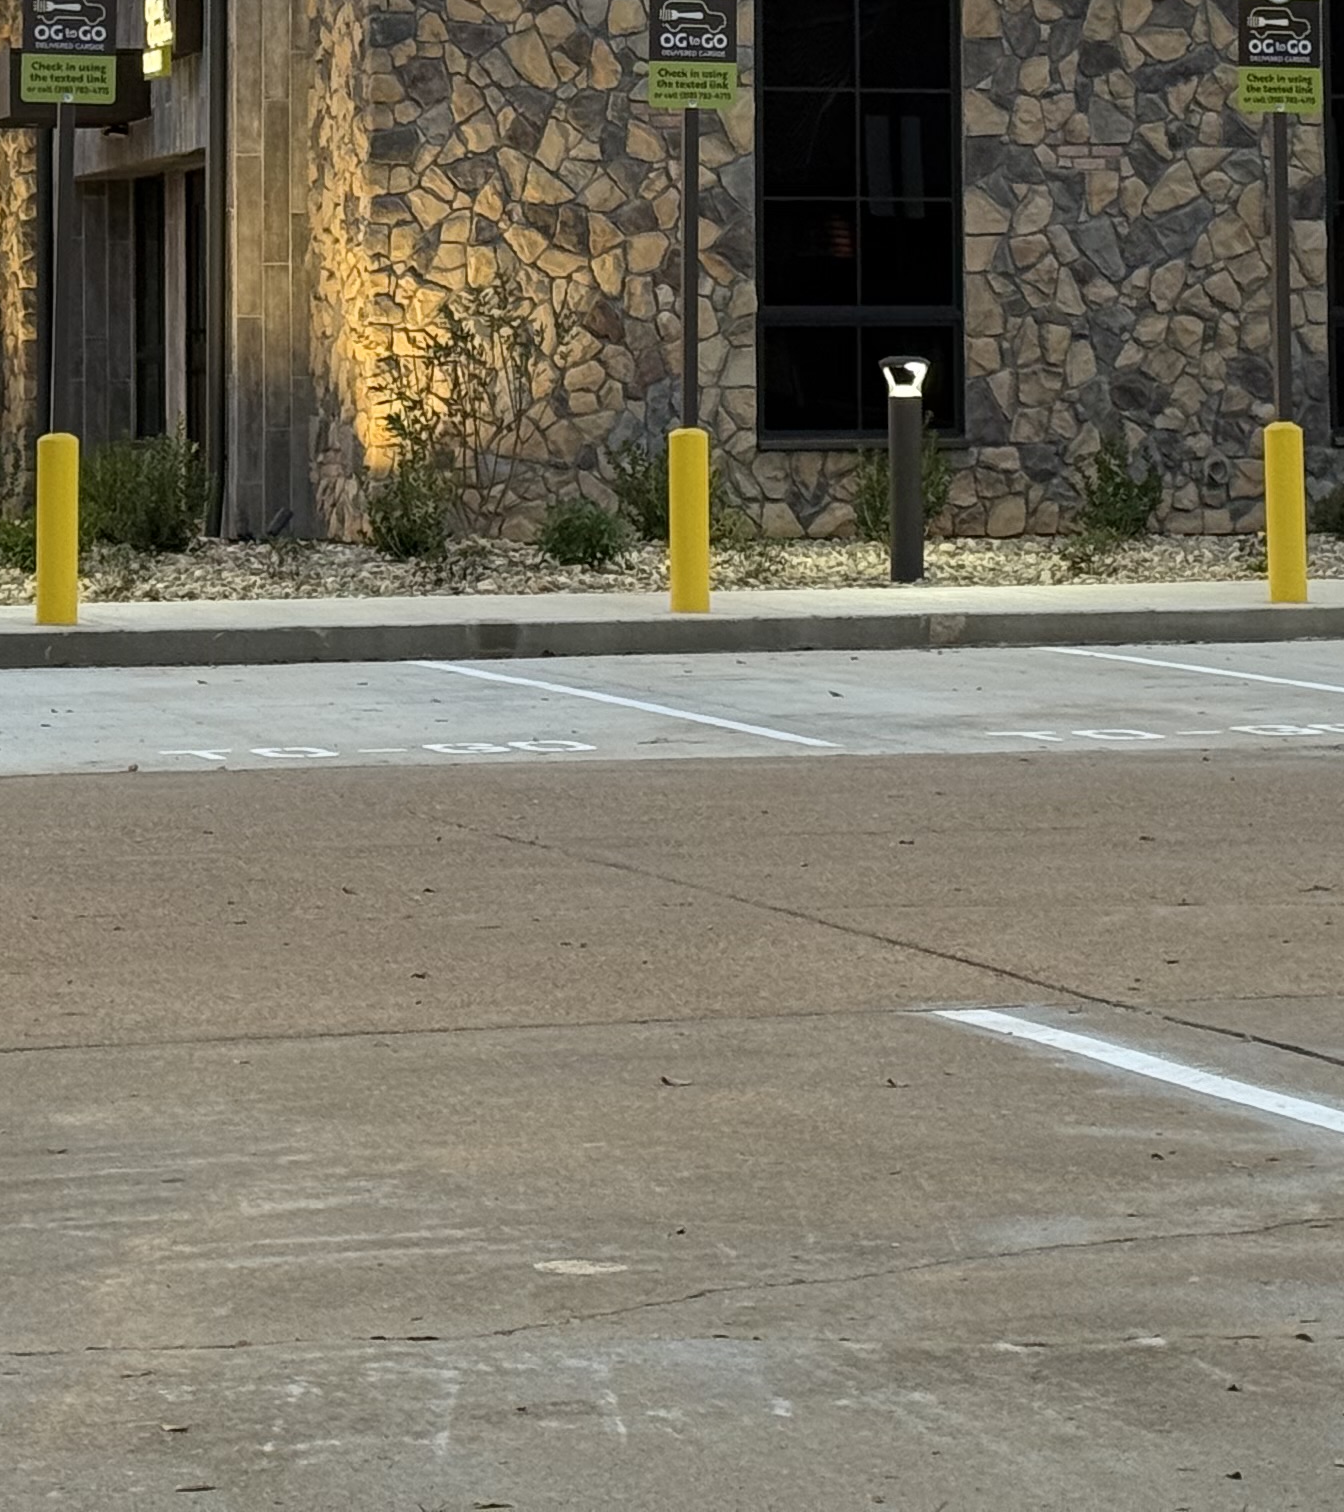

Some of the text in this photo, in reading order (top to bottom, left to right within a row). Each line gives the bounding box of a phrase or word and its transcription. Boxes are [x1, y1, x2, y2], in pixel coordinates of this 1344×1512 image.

[34, 24, 107, 42] OG to GO
[660, 33, 728, 49] OG to GO
[1248, 39, 1312, 55] OG to GO
[31, 61, 106, 74] Check in using
[657, 67, 728, 81] Check in using
[29, 73, 107, 83] the texted link
[656, 79, 729, 89] the texted link
[158, 738, 598, 761] TO-GO
